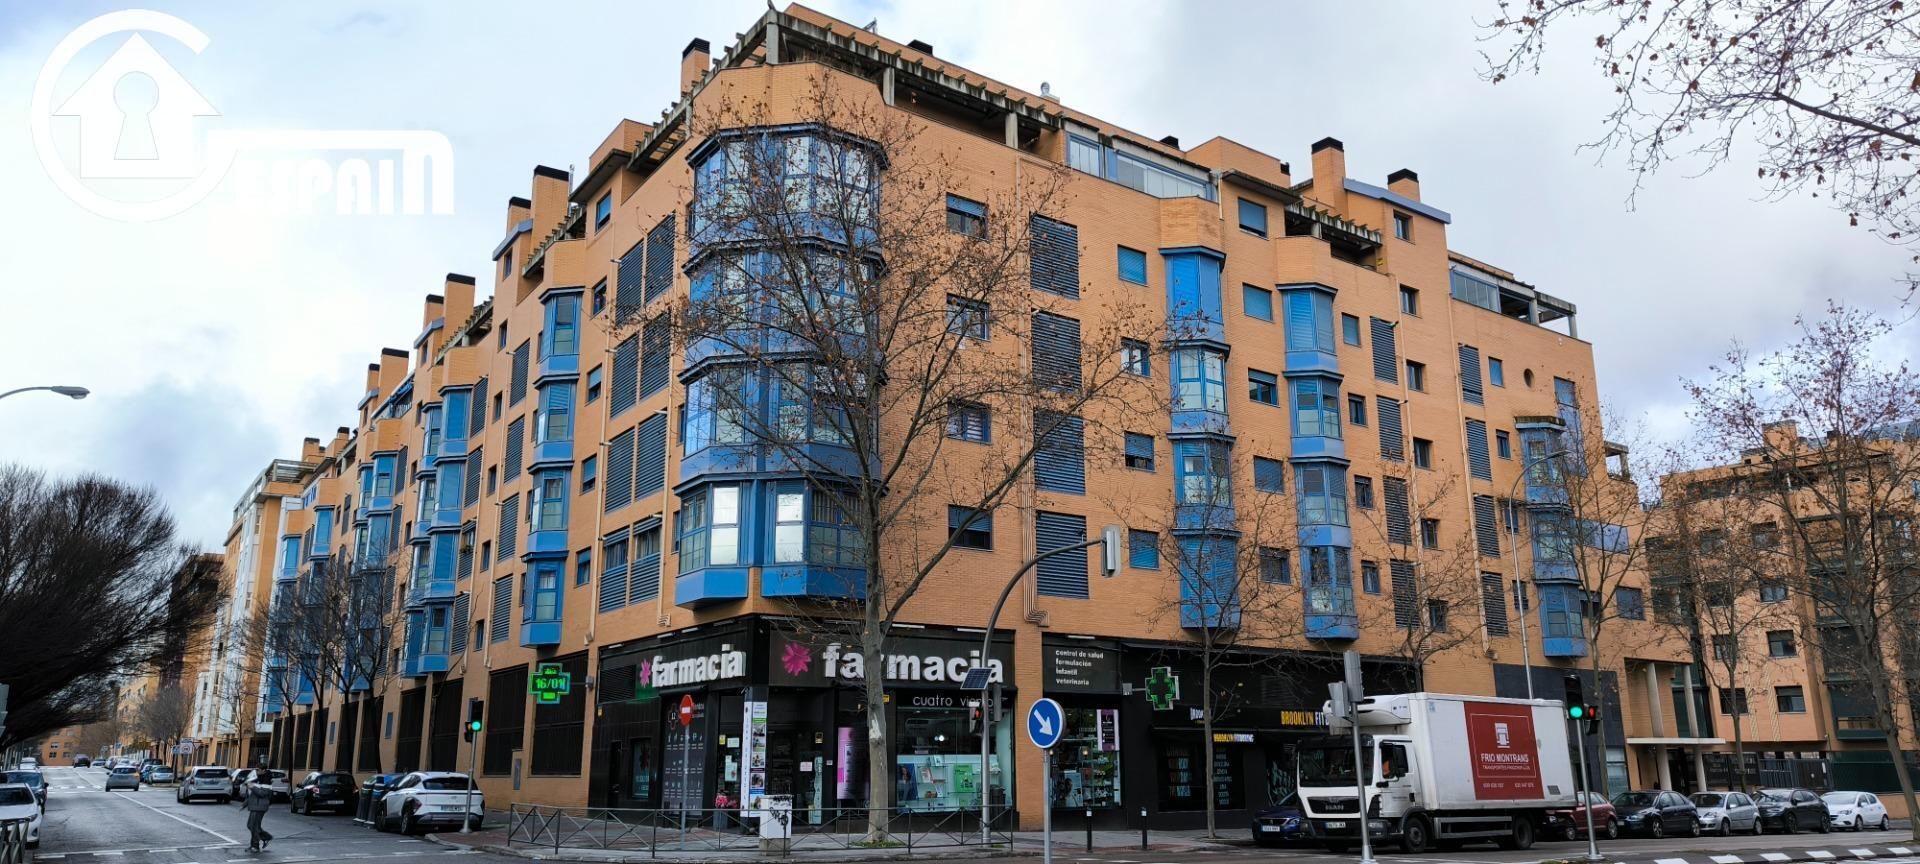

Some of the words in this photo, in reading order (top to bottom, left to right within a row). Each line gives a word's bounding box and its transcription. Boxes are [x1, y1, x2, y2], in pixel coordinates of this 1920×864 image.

[652, 644, 746, 687] farmacia
[823, 642, 1003, 683] famacia
[912, 694, 953, 707] cuatro
[1281, 710, 1314, 726] BROOKLYN
[1480, 752, 1495, 763] FRIO
[1496, 753, 1529, 763] MONTRANS
